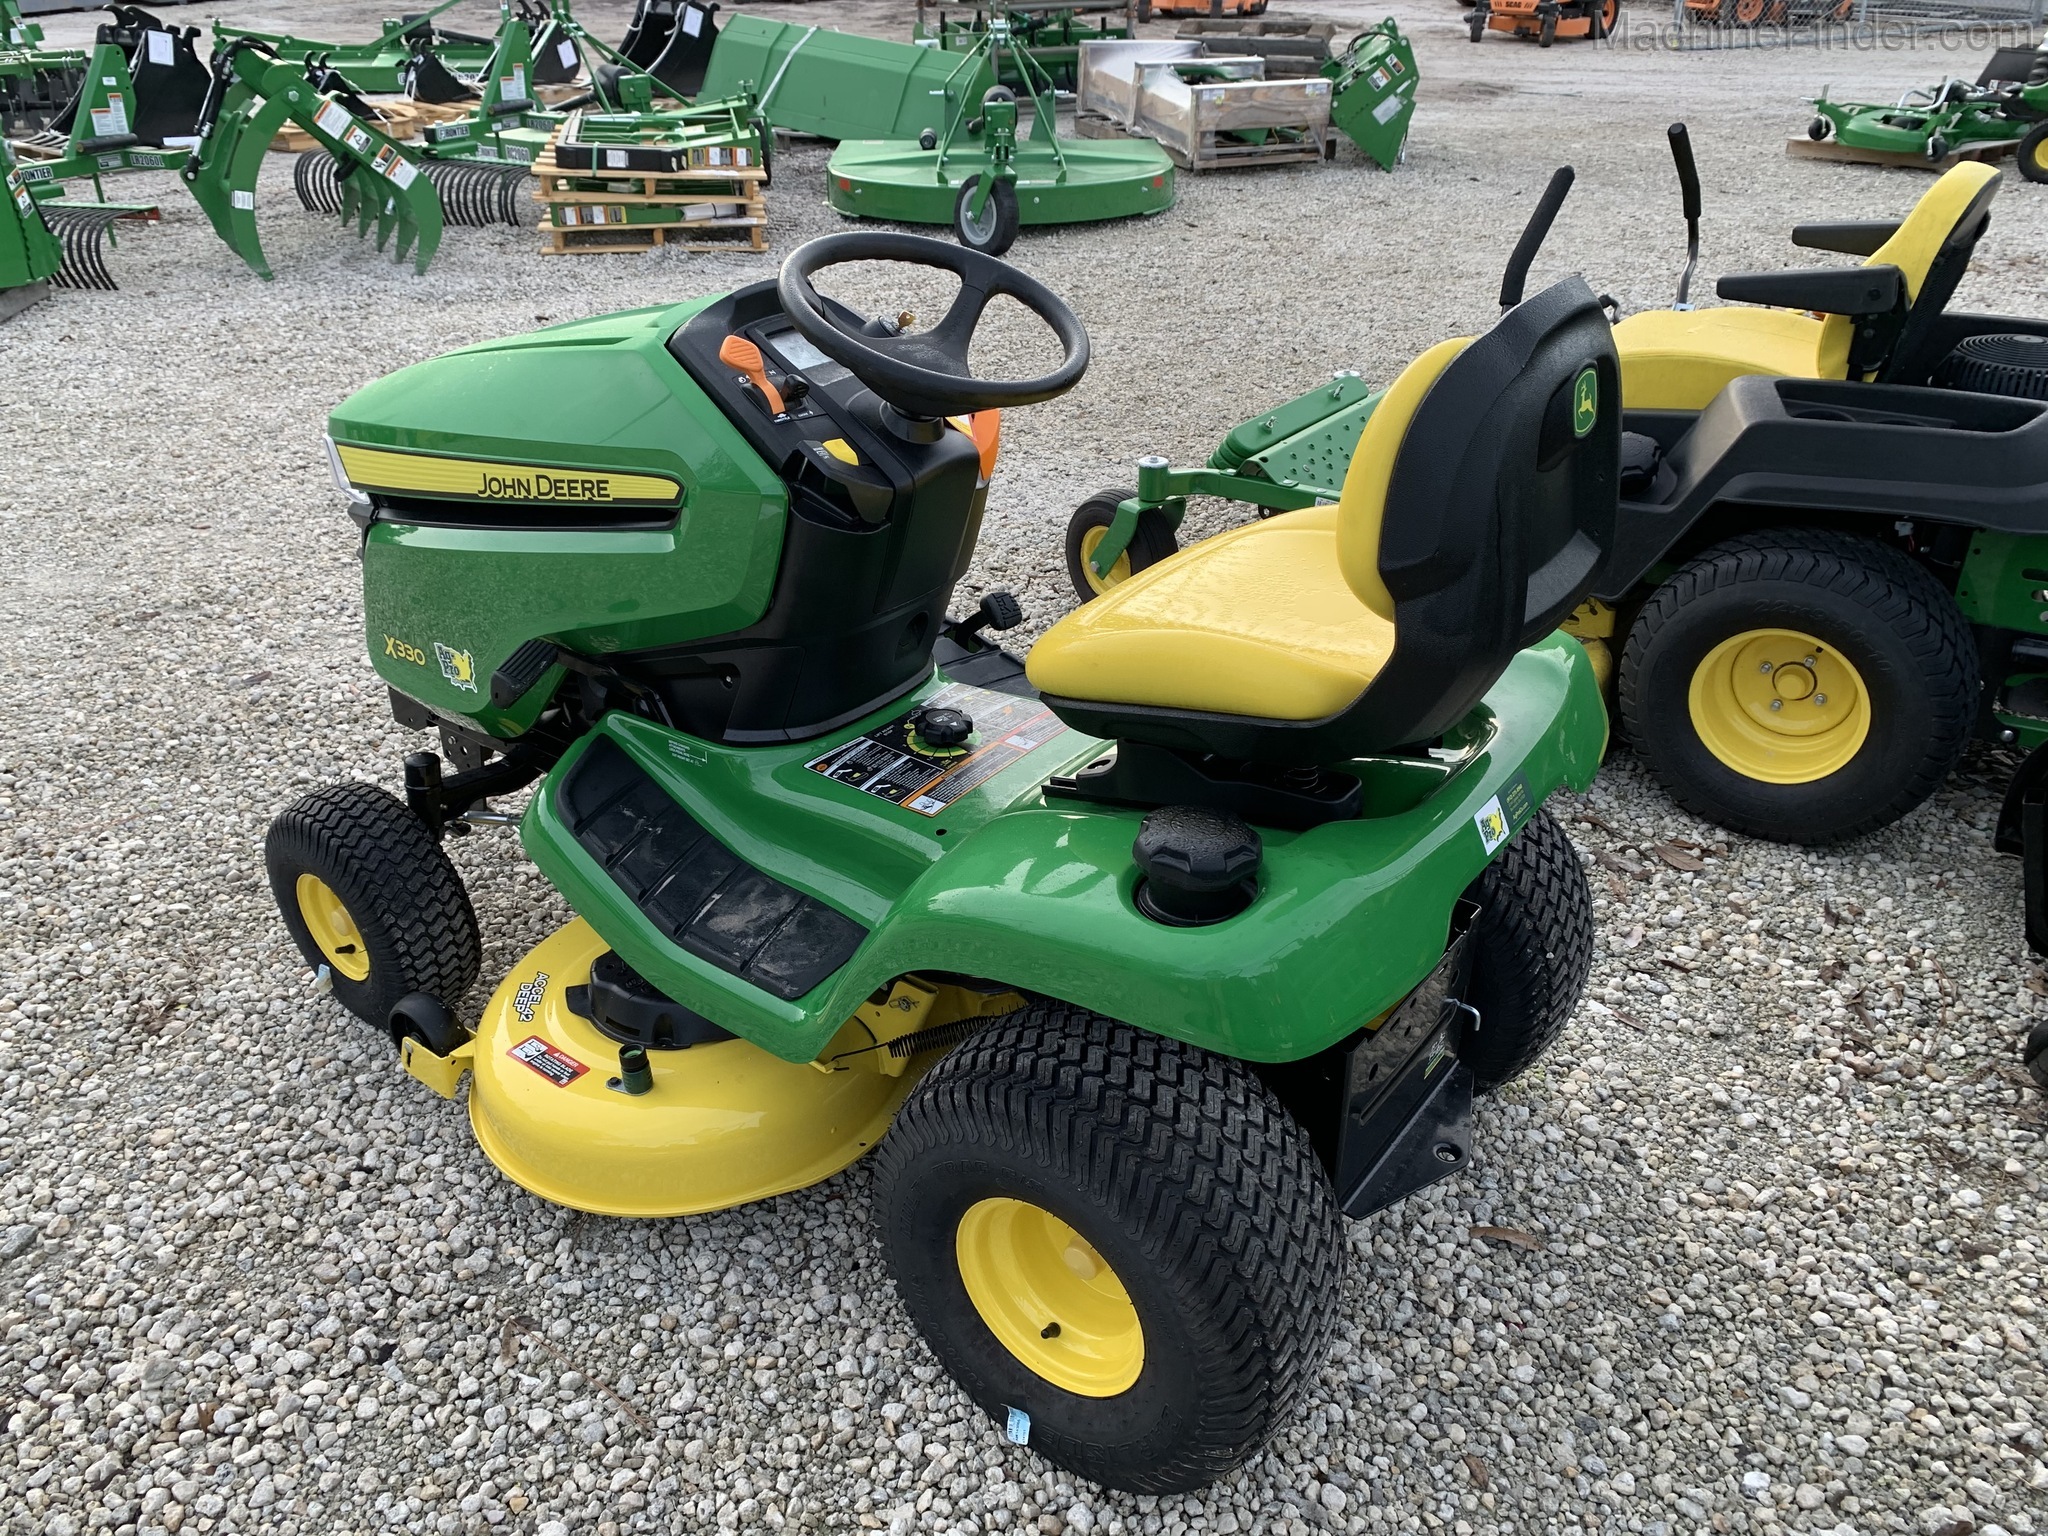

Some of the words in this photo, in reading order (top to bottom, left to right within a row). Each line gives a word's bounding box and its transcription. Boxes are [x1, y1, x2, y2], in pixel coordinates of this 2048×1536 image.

[131, 154, 164, 167] LR2060L
[477, 473, 532, 496] JOHN
[535, 474, 611, 499] DEERE
[383, 633, 426, 666] X330
[443, 661, 460, 676] Pro
[513, 982, 533, 1013] DEEP
[526, 971, 550, 1008] ACCEL
[518, 1006, 535, 1022] 42
[559, 1053, 579, 1068] DANGER
